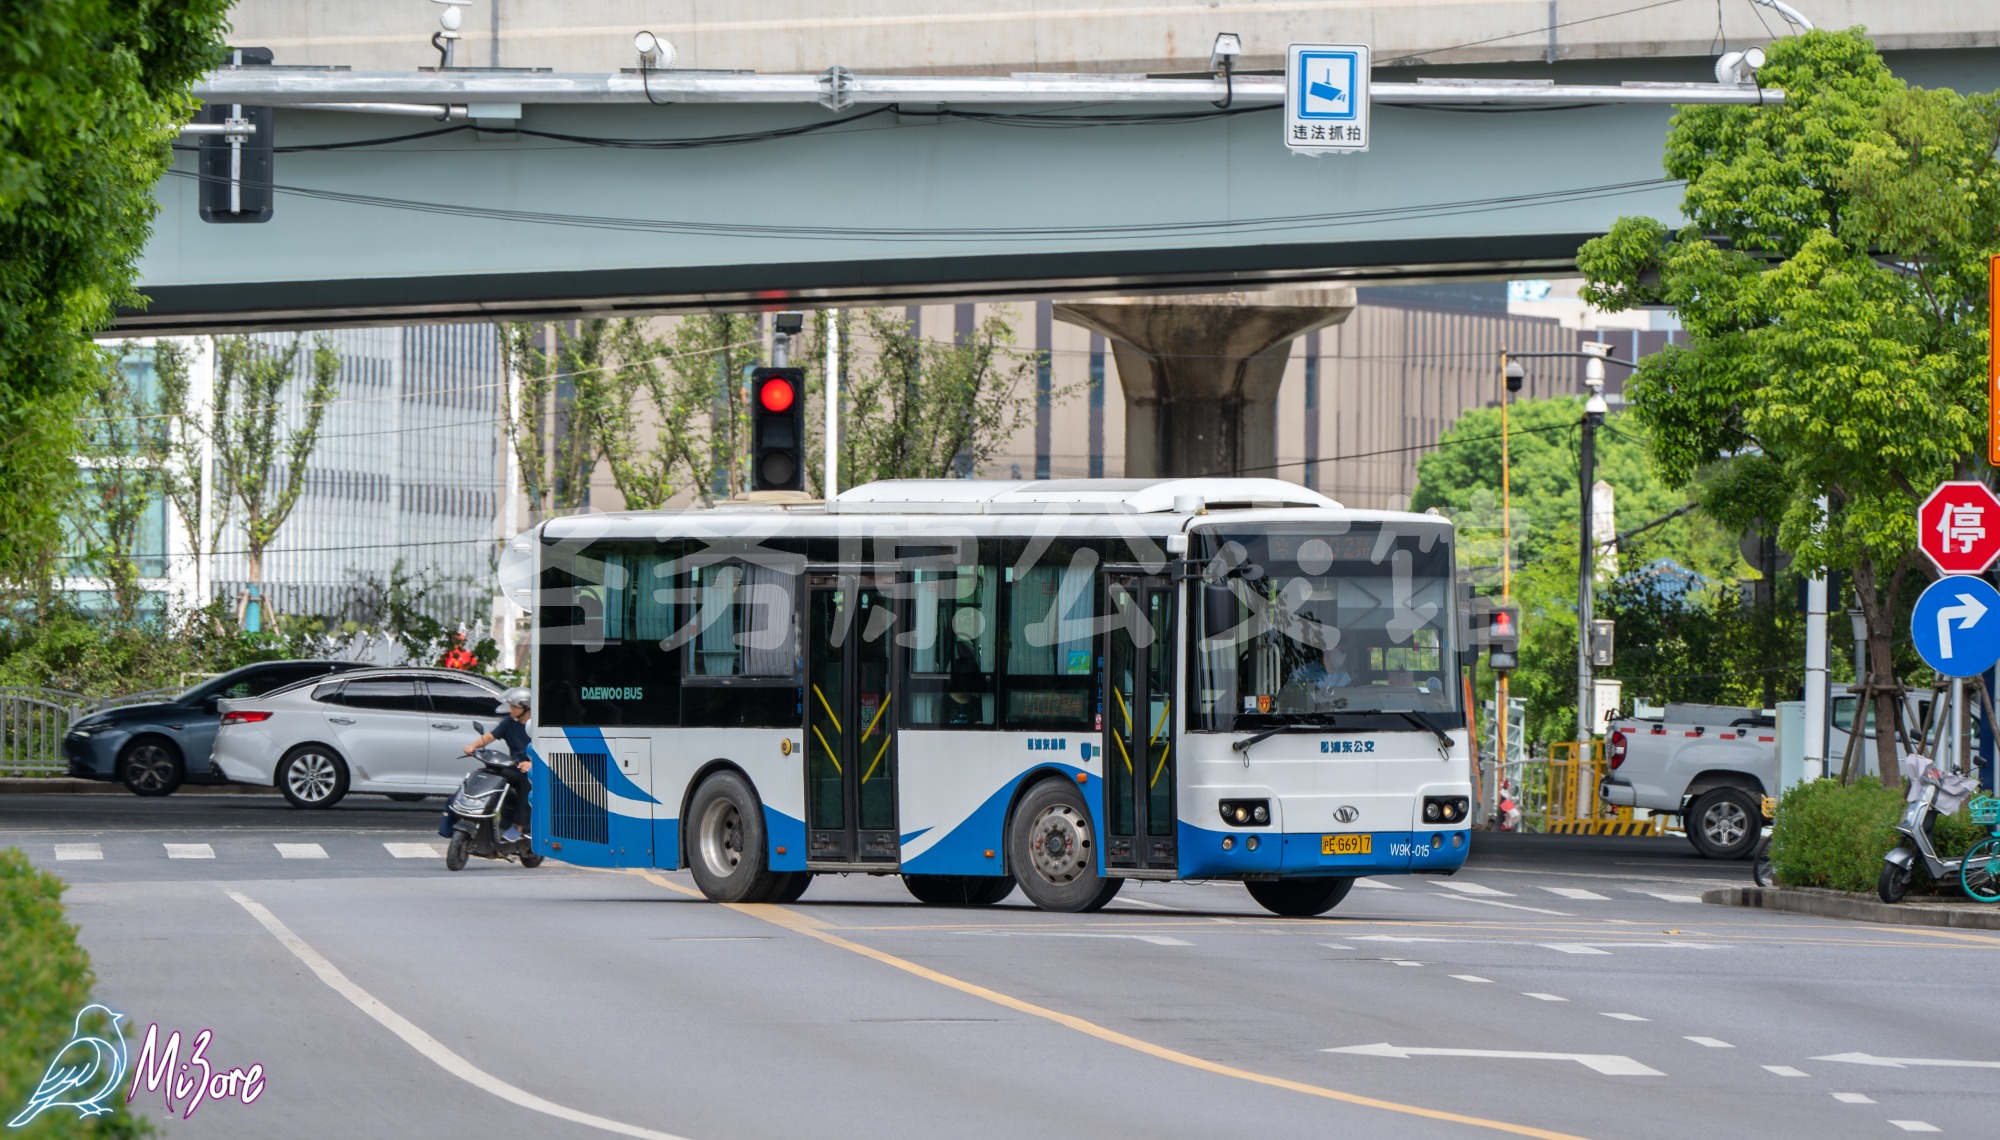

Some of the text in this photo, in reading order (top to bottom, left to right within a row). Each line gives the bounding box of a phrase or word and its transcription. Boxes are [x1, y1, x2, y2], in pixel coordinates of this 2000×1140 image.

[1293, 125, 1361, 141] 违法抓拍
[1936, 502, 1986, 554] 停
[581, 687, 643, 700] DAEWOO BUS
[1330, 740, 1375, 753] 浦东公交
[1390, 843, 1430, 857] W9K-015
